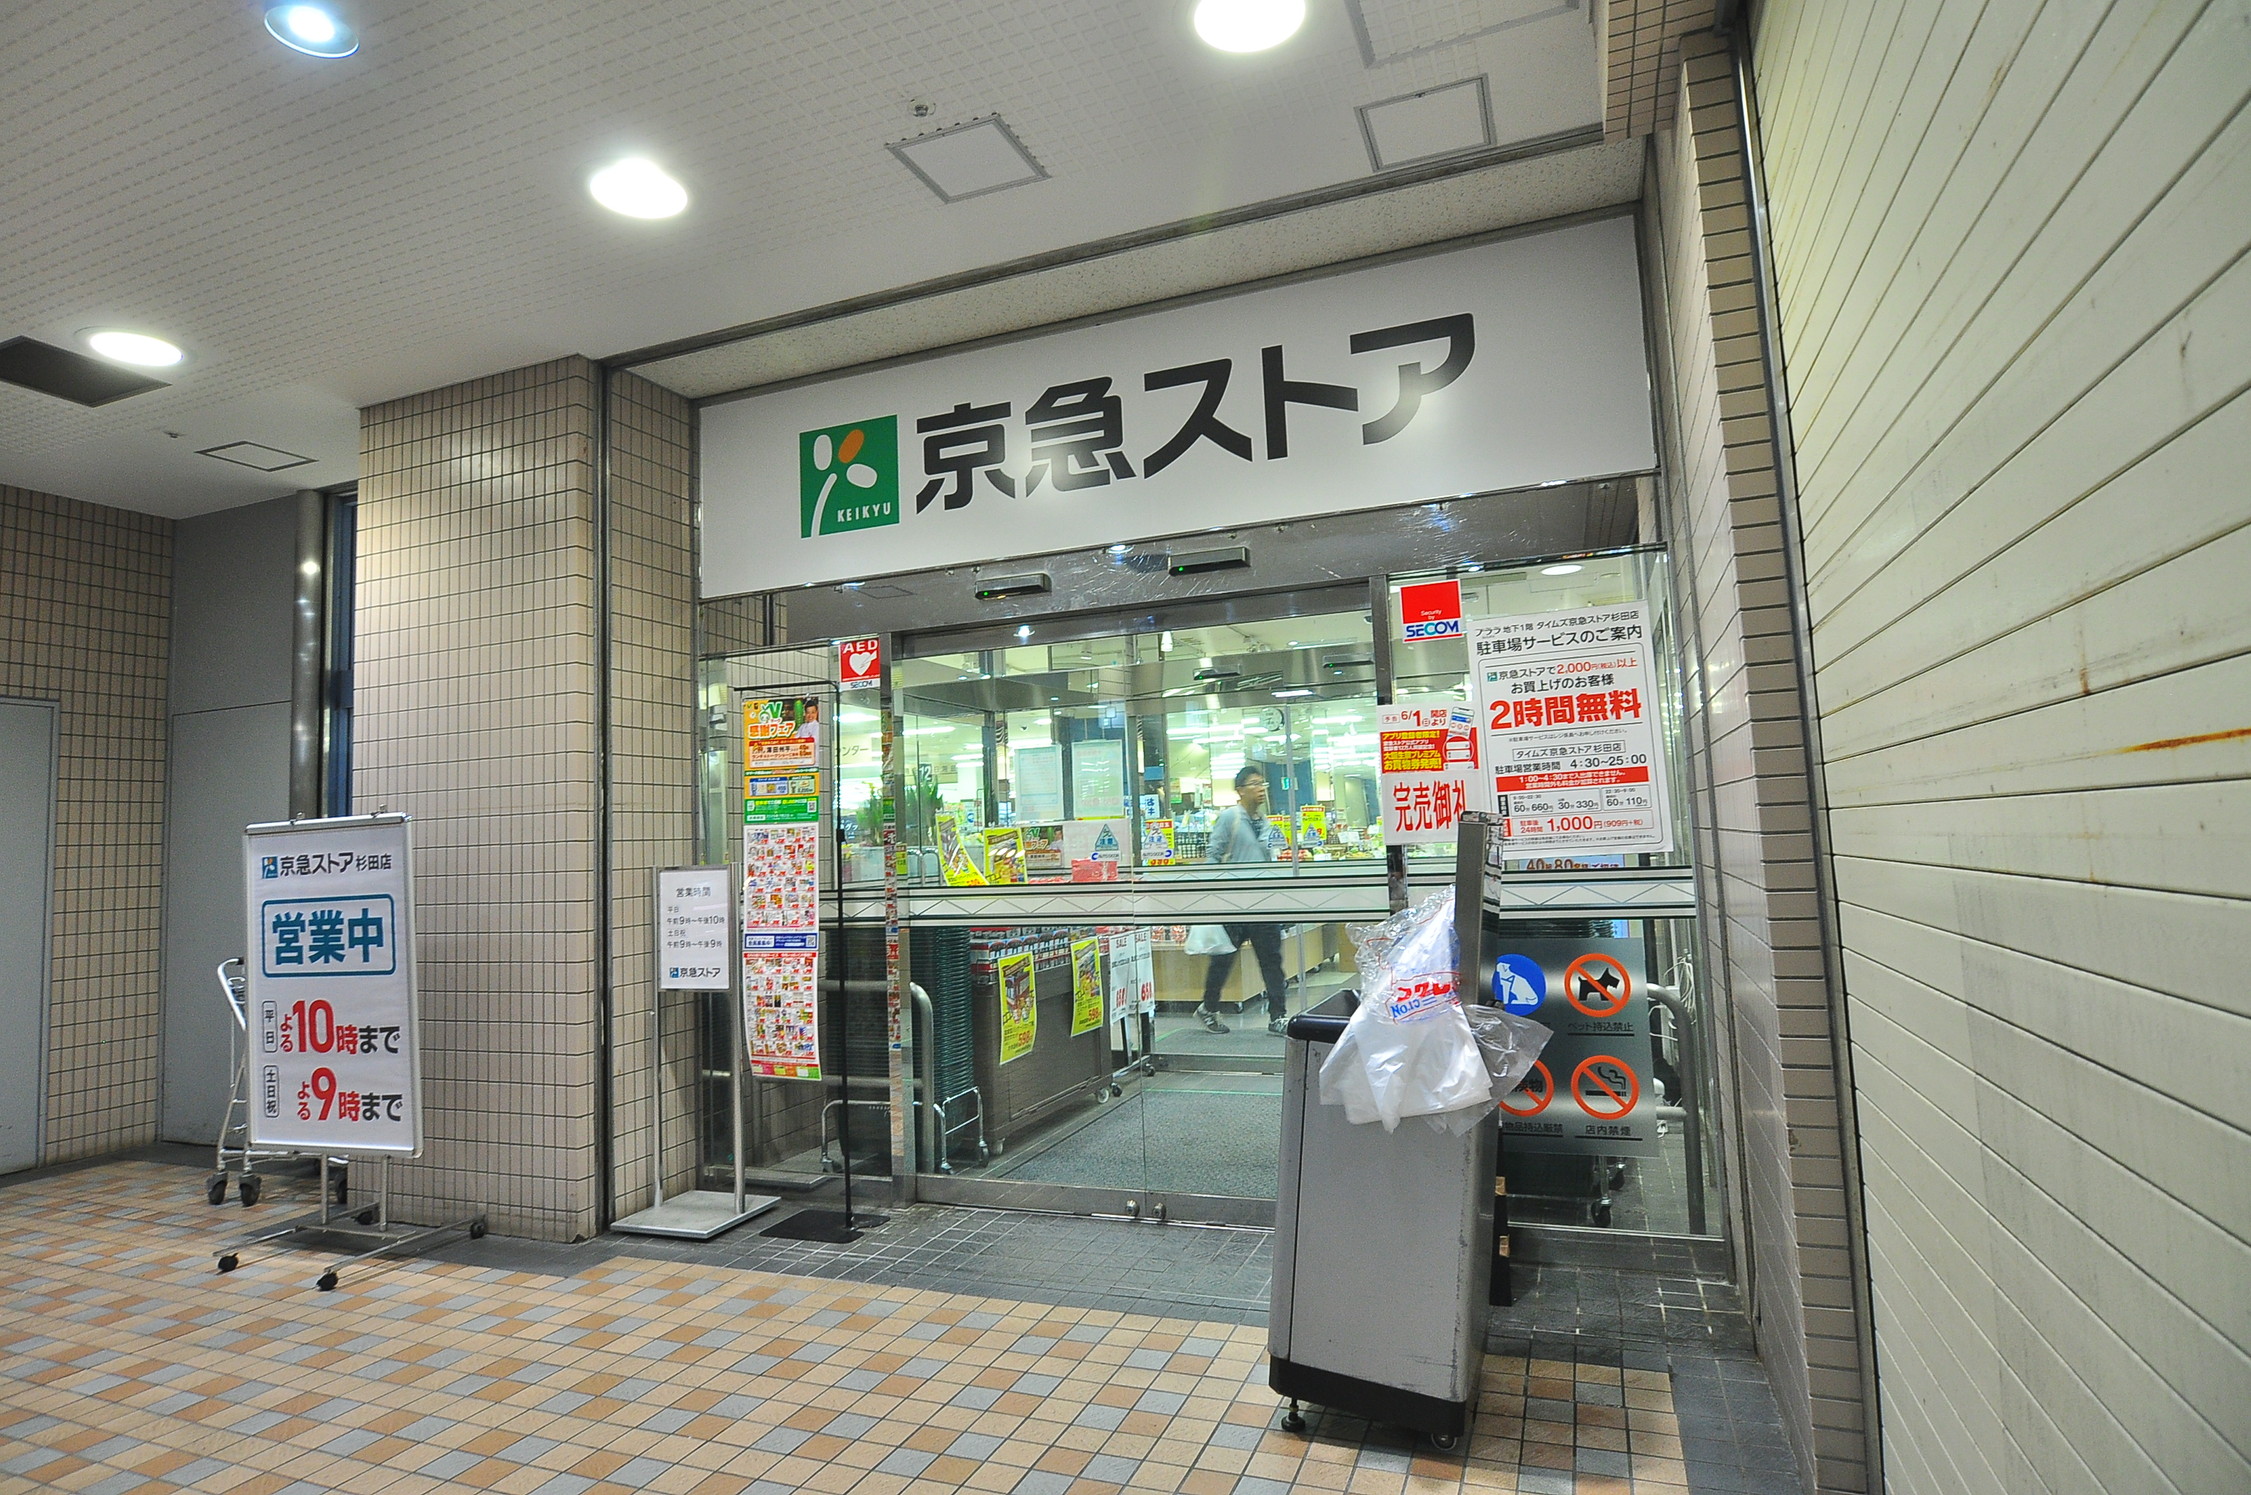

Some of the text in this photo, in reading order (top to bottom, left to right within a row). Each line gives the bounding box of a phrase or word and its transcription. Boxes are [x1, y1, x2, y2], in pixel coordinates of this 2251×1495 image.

[916, 312, 1476, 514] 京急ストア
[837, 502, 891, 523] KEIKYU
[1420, 609, 1442, 617] Security
[1537, 610, 1639, 630] タイムズ京急ストア杉田店
[1406, 620, 1460, 638] SECOM
[843, 639, 878, 655] AED
[1476, 625, 1643, 656] 駐車場サービスのご案内
[1511, 673, 1615, 695] お買上げのお客様
[1489, 688, 1642, 730] 2時間無料
[1431, 718, 1446, 727] より
[1516, 743, 1622, 759] タイムズ京急ストア杉田店
[919, 766, 932, 781] 12
[1495, 761, 1562, 775] 駐車場営業時間
[280, 852, 392, 876] 京急ストア杉田店
[676, 886, 711, 898] 営業時間
[272, 908, 384, 965] 営業中
[680, 967, 721, 978] 京急ストア
[265, 1008, 275, 1044] 平日
[1567, 1022, 1634, 1032] ペット持込禁止
[266, 1069, 278, 1114] 土日祝
[1585, 1125, 1631, 1136] 店内禁煙
